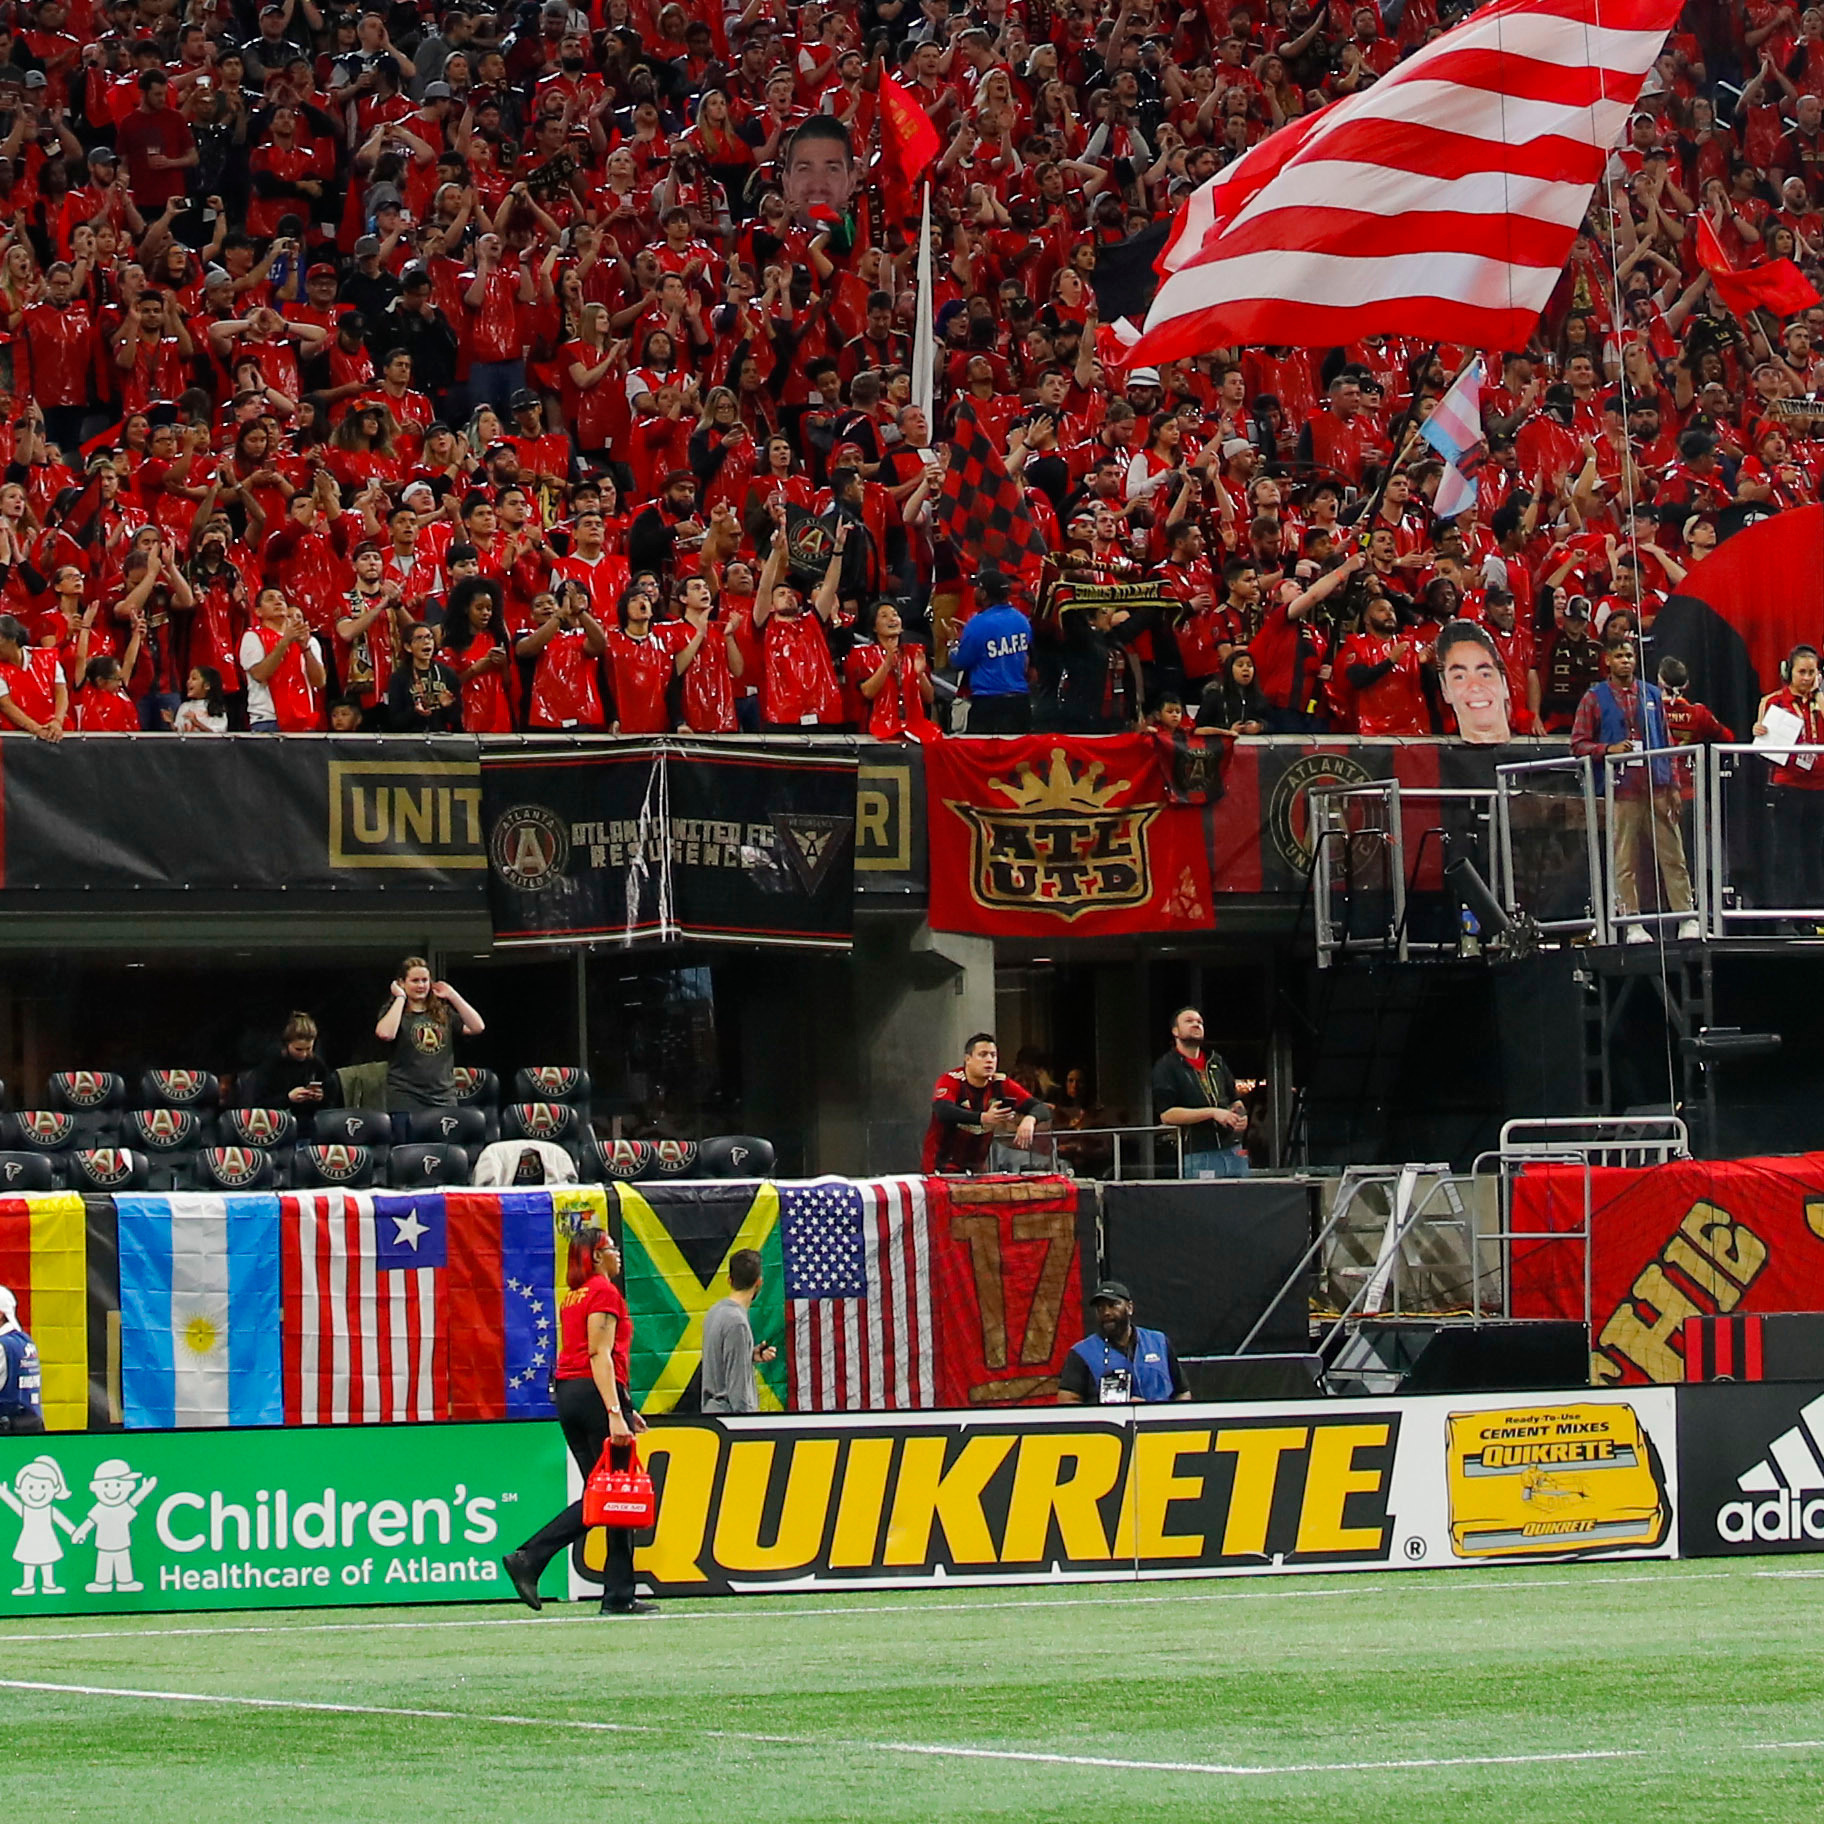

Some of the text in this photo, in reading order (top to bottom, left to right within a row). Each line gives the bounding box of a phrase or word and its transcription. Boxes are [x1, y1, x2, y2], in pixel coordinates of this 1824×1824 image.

[1287, 756, 1367, 790] ATLANTA
[501, 809, 556, 830] ATLANTA
[745, 823, 775, 849] FC
[519, 827, 549, 872] A
[991, 821, 1134, 861] ATL
[993, 862, 1136, 897] UTD
[950, 1212, 1078, 1370] 17
[1480, 1420, 1610, 1441] CEMENT MIXES
[1504, 1413, 1581, 1428] Ready-To-Use
[1482, 1437, 1616, 1467] QUIKRETE
[155, 1482, 498, 1553] Children's
[582, 1422, 1389, 1584] QUIKRETE
[1521, 1518, 1596, 1538] QUIKRETE
[159, 1555, 498, 1592] Healthcare of Atlanta
